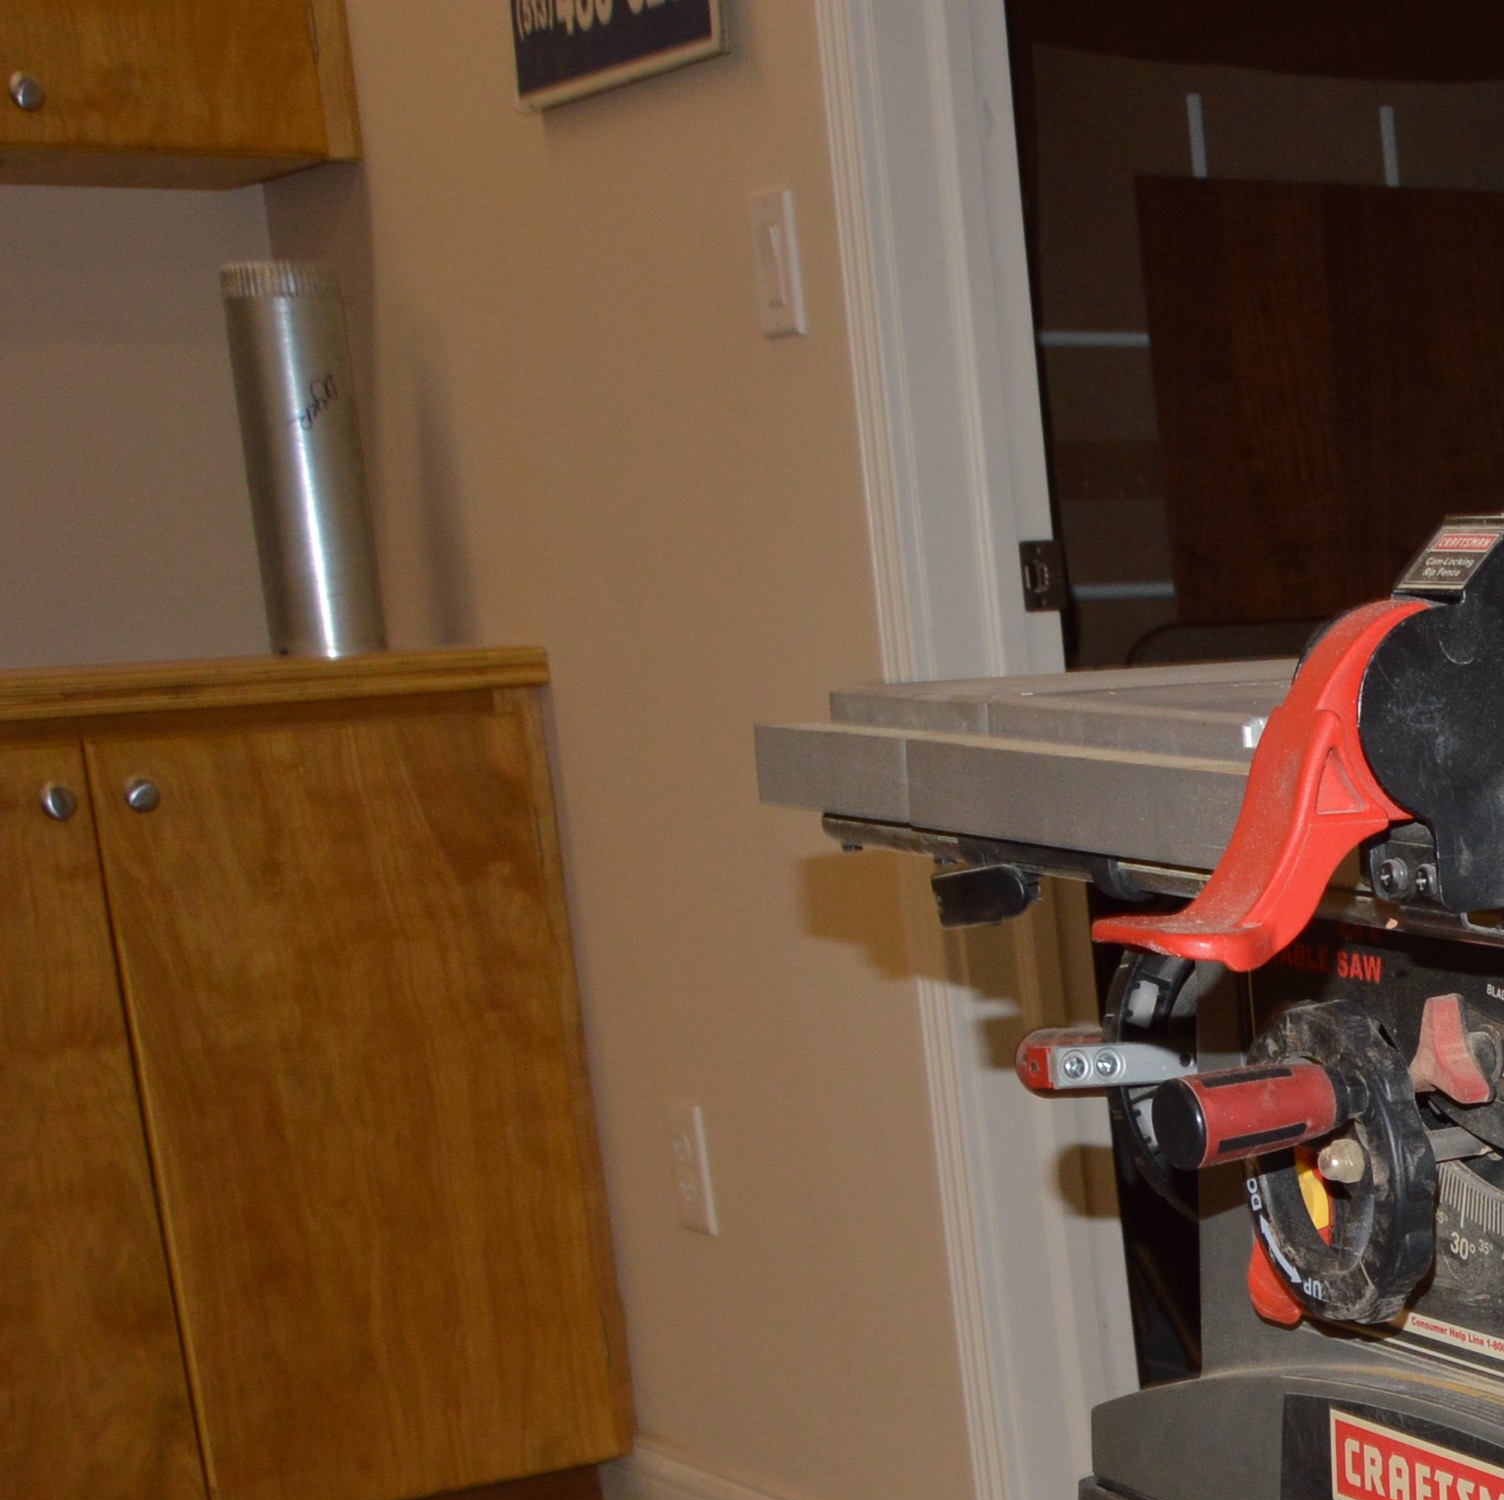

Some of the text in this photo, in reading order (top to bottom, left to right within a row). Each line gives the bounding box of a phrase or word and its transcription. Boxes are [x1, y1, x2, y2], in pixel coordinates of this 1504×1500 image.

[1422, 567, 1462, 577] Rip Fence
[1337, 950, 1383, 985] SAW
[1450, 1231, 1476, 1260] 30°
[1478, 1238, 1494, 1255] 35°
[1302, 1277, 1323, 1301] UP
[1411, 1316, 1448, 1336] Consumer
[1449, 1328, 1467, 1342] Help
[1468, 1331, 1485, 1346] Line
